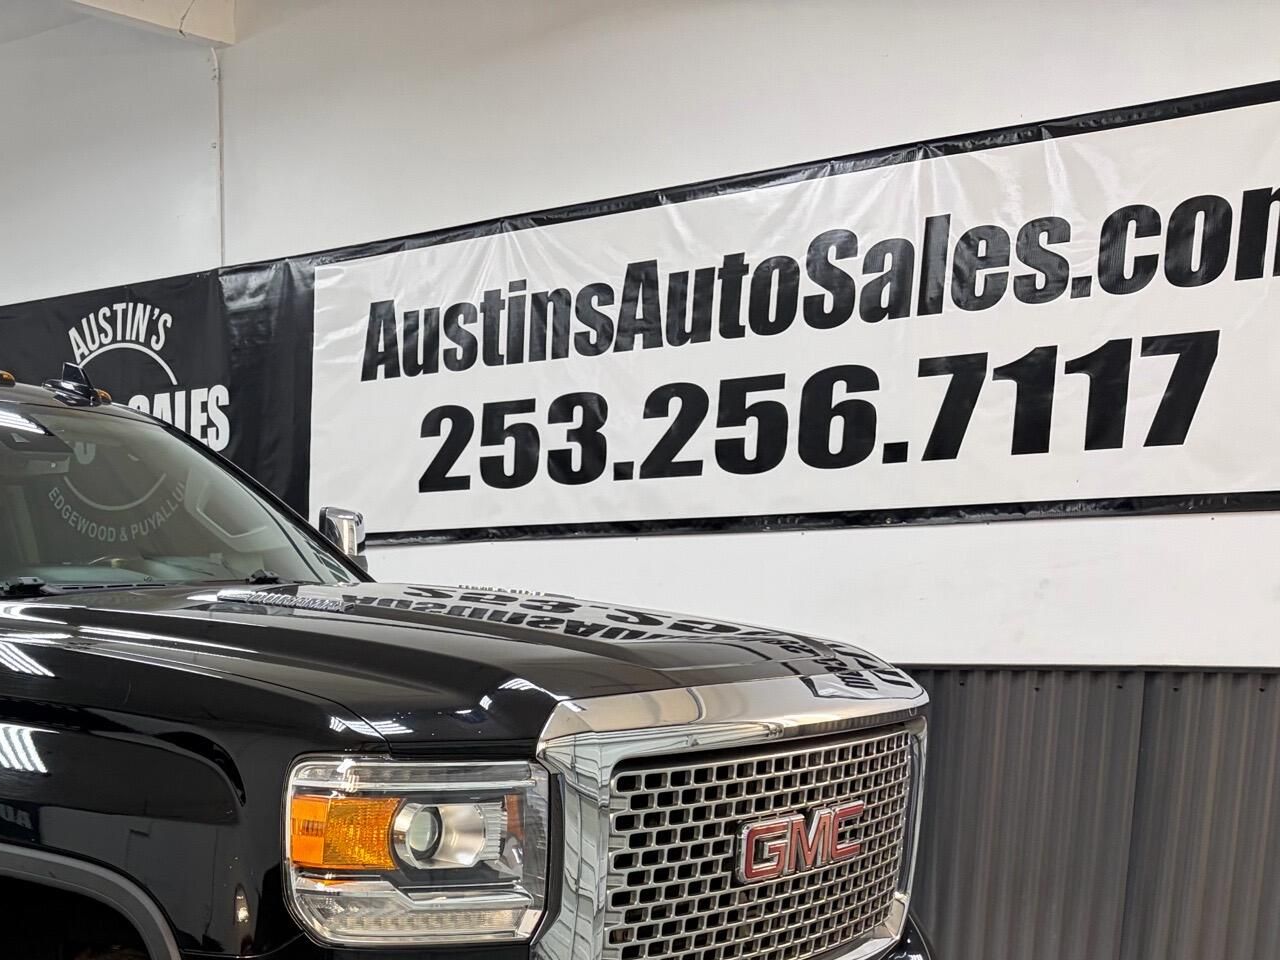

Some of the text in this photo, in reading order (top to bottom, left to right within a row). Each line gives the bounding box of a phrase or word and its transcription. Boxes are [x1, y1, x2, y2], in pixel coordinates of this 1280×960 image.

[68, 302, 173, 364] AUSTIN'S
[128, 384, 231, 451] LES
[417, 329, 1221, 494] 253.256.7117
[48, 487, 117, 543] EDGEWOOD
[120, 527, 129, 542] &
[734, 800, 865, 884] GMC
